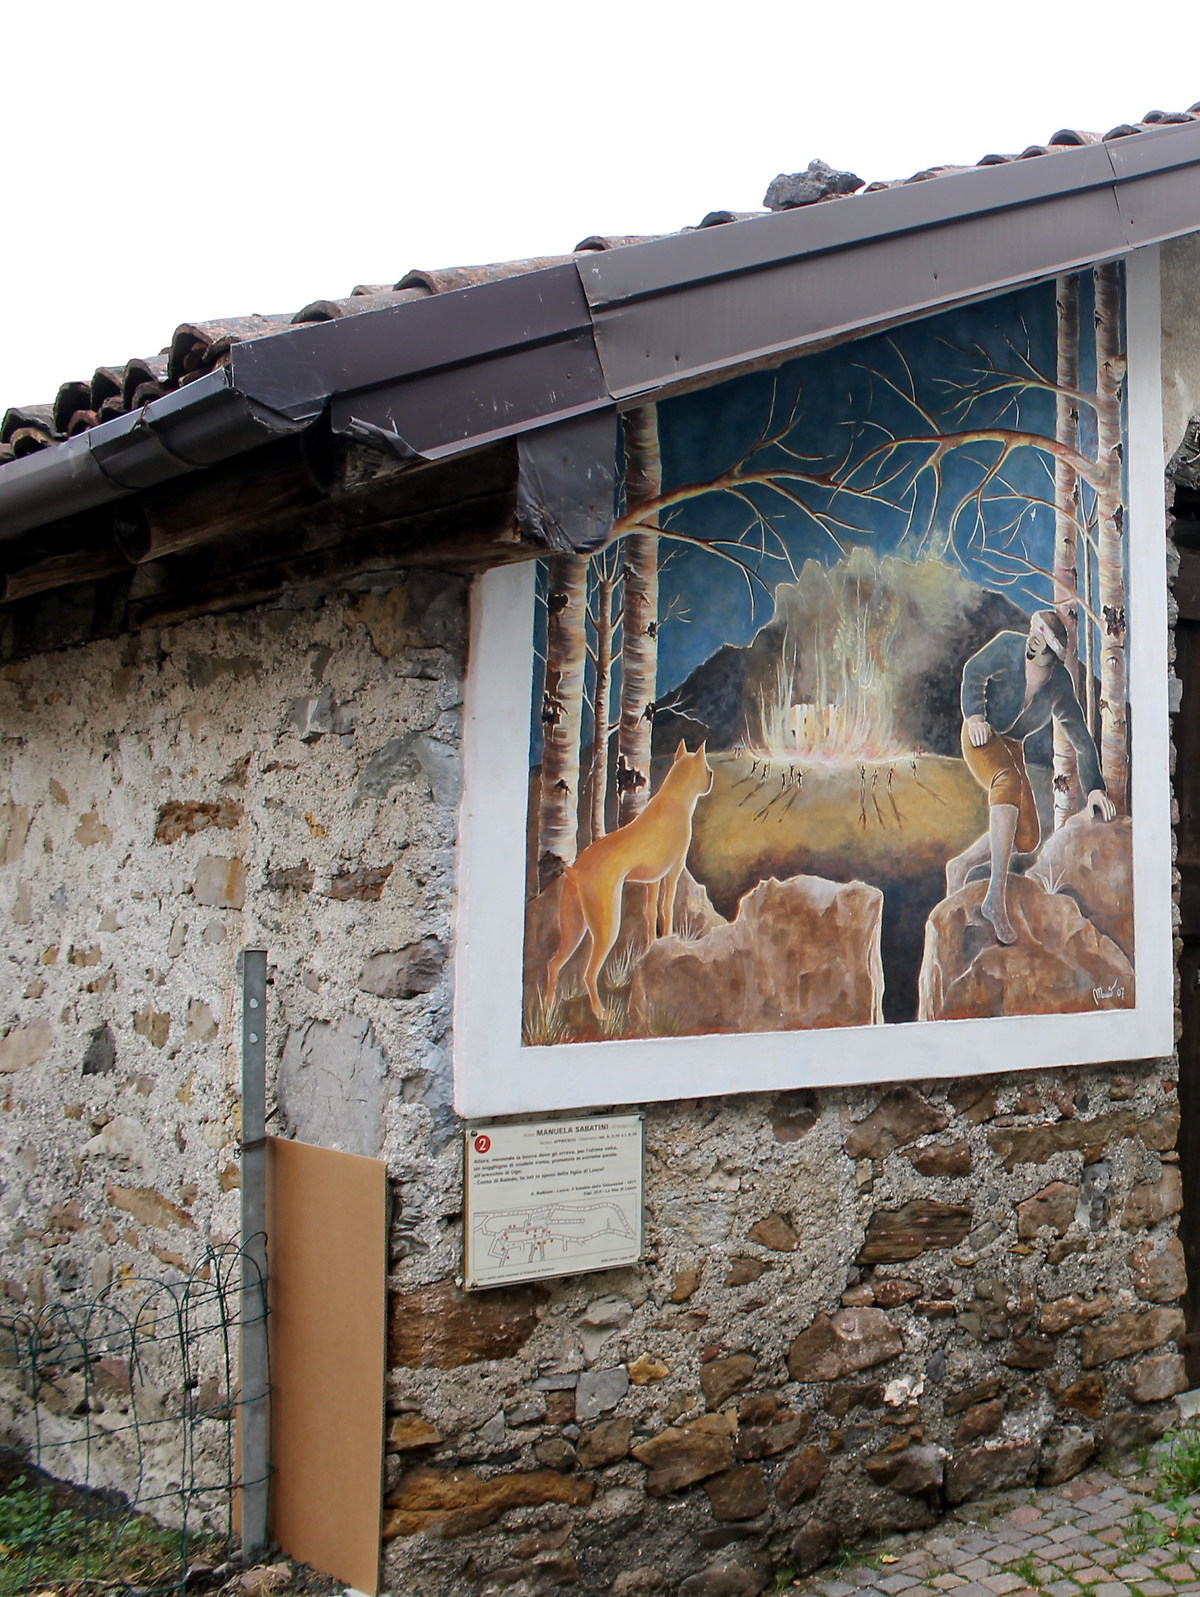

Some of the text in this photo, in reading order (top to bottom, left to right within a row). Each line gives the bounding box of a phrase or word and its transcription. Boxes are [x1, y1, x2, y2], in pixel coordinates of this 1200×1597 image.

[536, 1127, 573, 1136] MANUELA
[575, 1124, 608, 1132] SABATINI
[478, 1138, 486, 1151] 2
